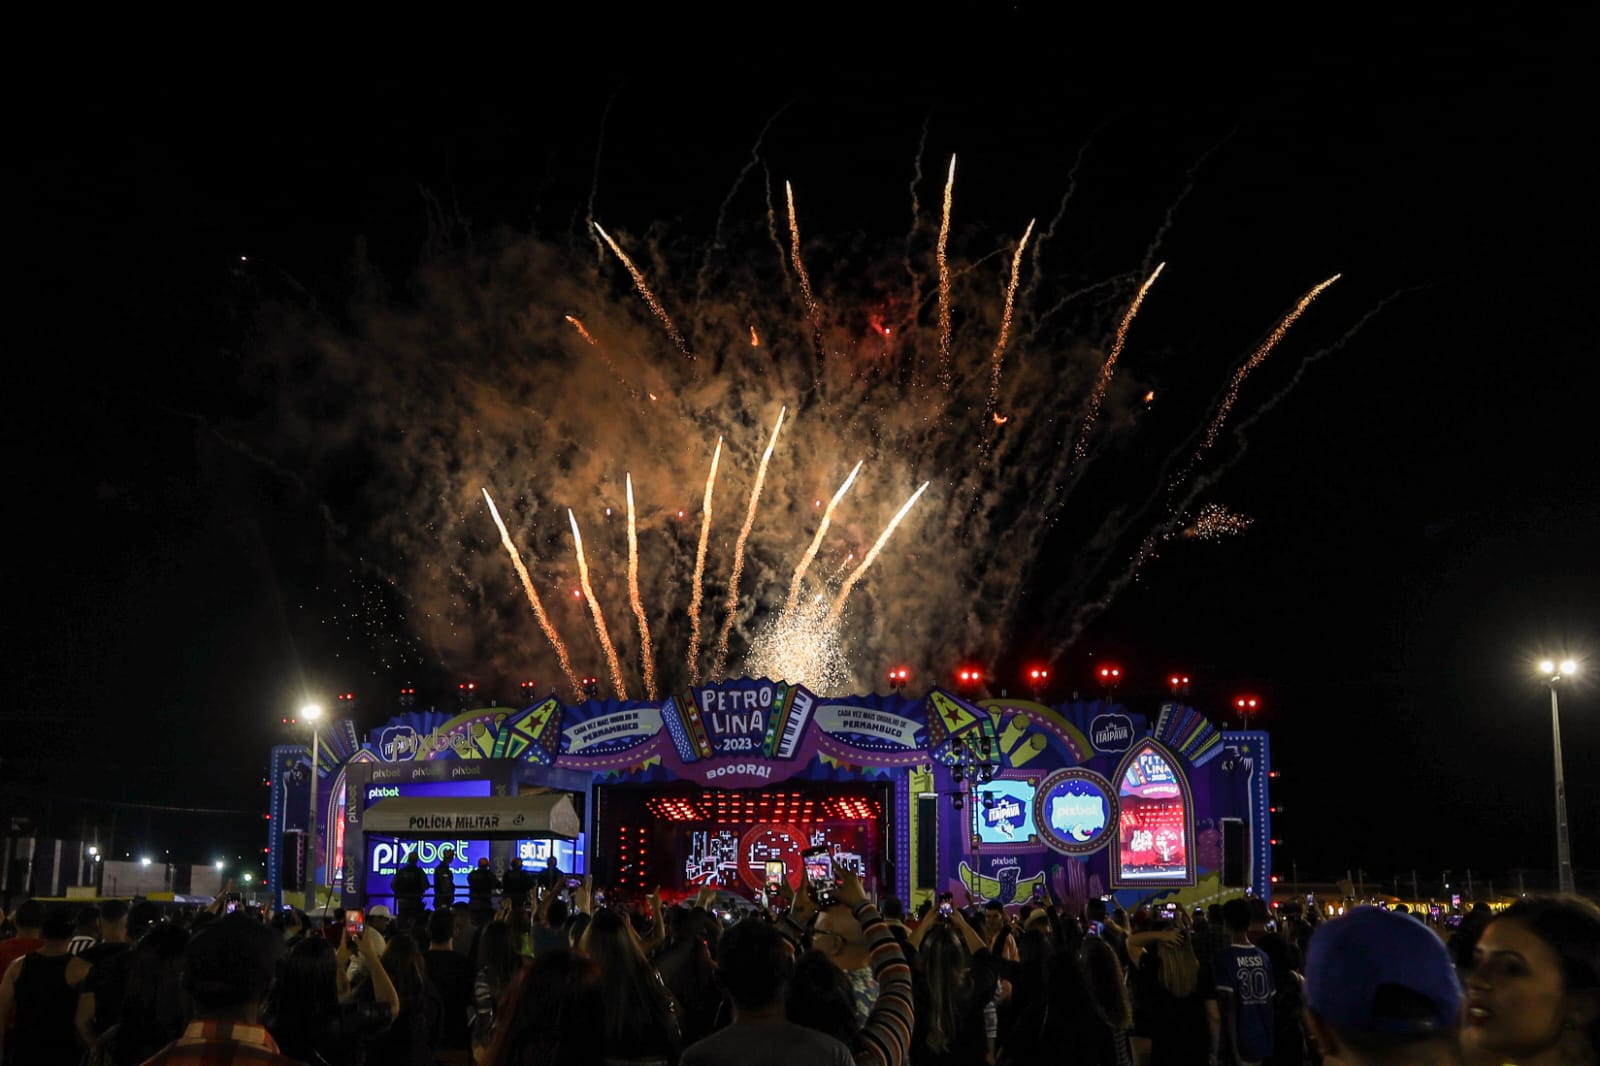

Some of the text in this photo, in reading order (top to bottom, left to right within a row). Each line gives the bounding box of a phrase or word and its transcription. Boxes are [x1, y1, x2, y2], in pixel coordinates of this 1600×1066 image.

[701, 686, 772, 712] PETRO
[711, 710, 763, 734] LINA
[843, 720, 902, 737] PERNAMBUCO
[582, 722, 639, 743] PERNAMBUCO
[1095, 727, 1128, 744] ITAIPAVA
[392, 725, 478, 763] pixbet
[723, 738, 752, 751] 2023
[373, 768, 400, 780] pixbet
[706, 763, 772, 780] BOOORA!
[368, 786, 400, 800] pixbet
[988, 803, 1020, 822] ITAIPAVA
[409, 814, 499, 829] POLÍCIA MILITAR
[373, 837, 469, 872] pixbet
[991, 857, 1017, 867] pixbet
[1236, 956, 1263, 968] MESSI
[1236, 967, 1269, 1000] 30
